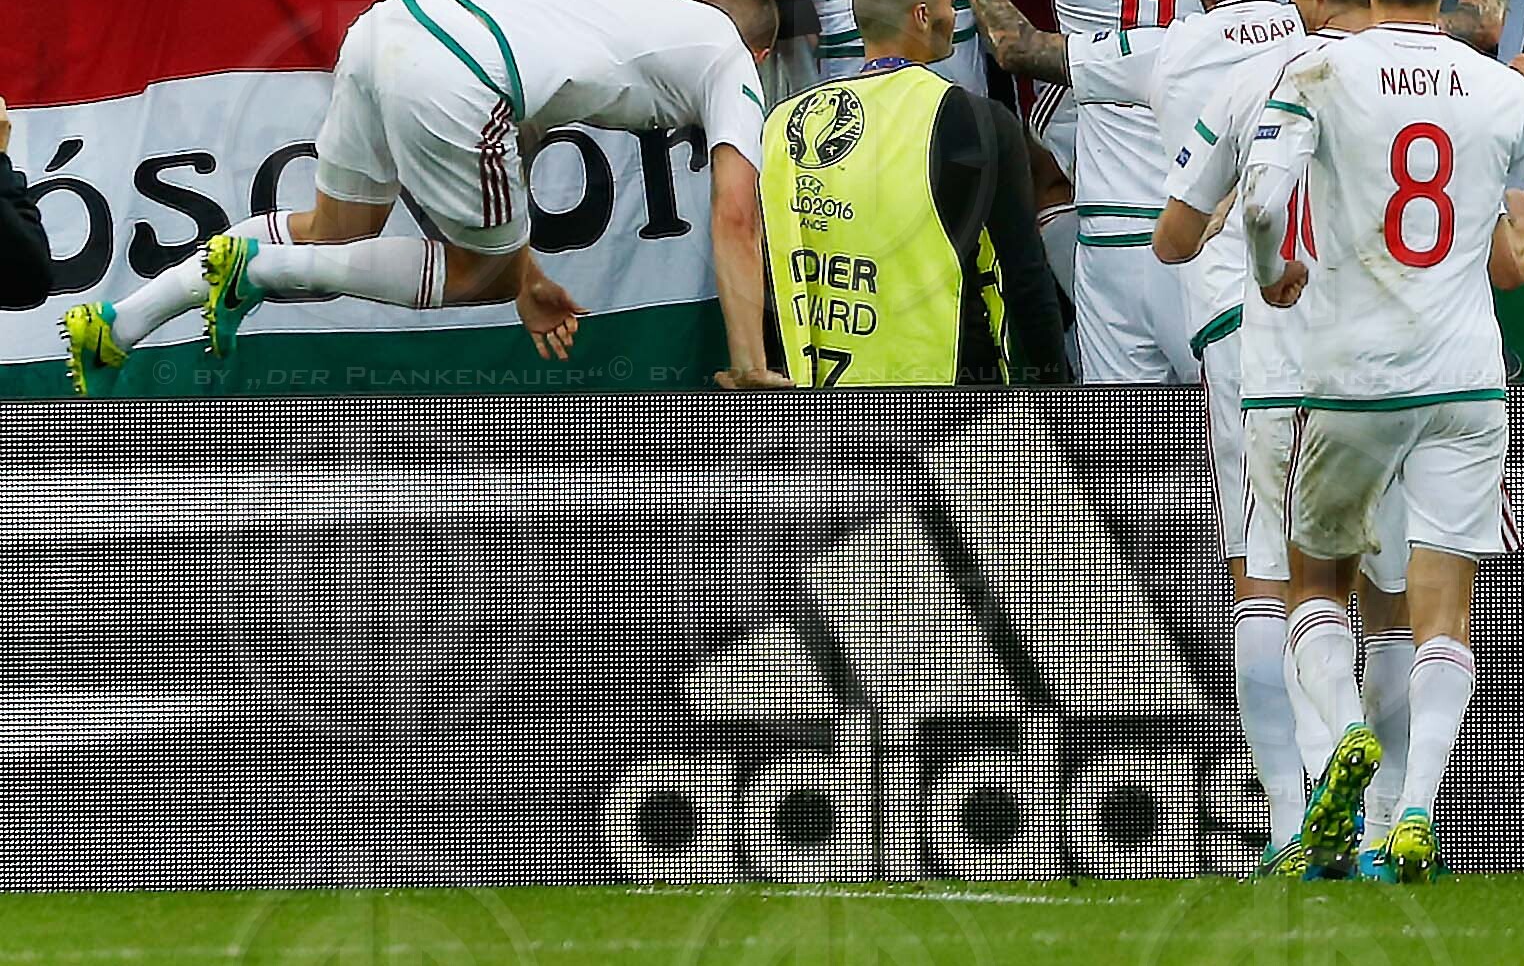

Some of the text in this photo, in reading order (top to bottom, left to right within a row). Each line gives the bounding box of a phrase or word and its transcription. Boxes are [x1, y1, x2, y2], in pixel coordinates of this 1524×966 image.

[1380, 62, 1470, 97] NAGY Á.
[1383, 121, 1456, 269] 8
